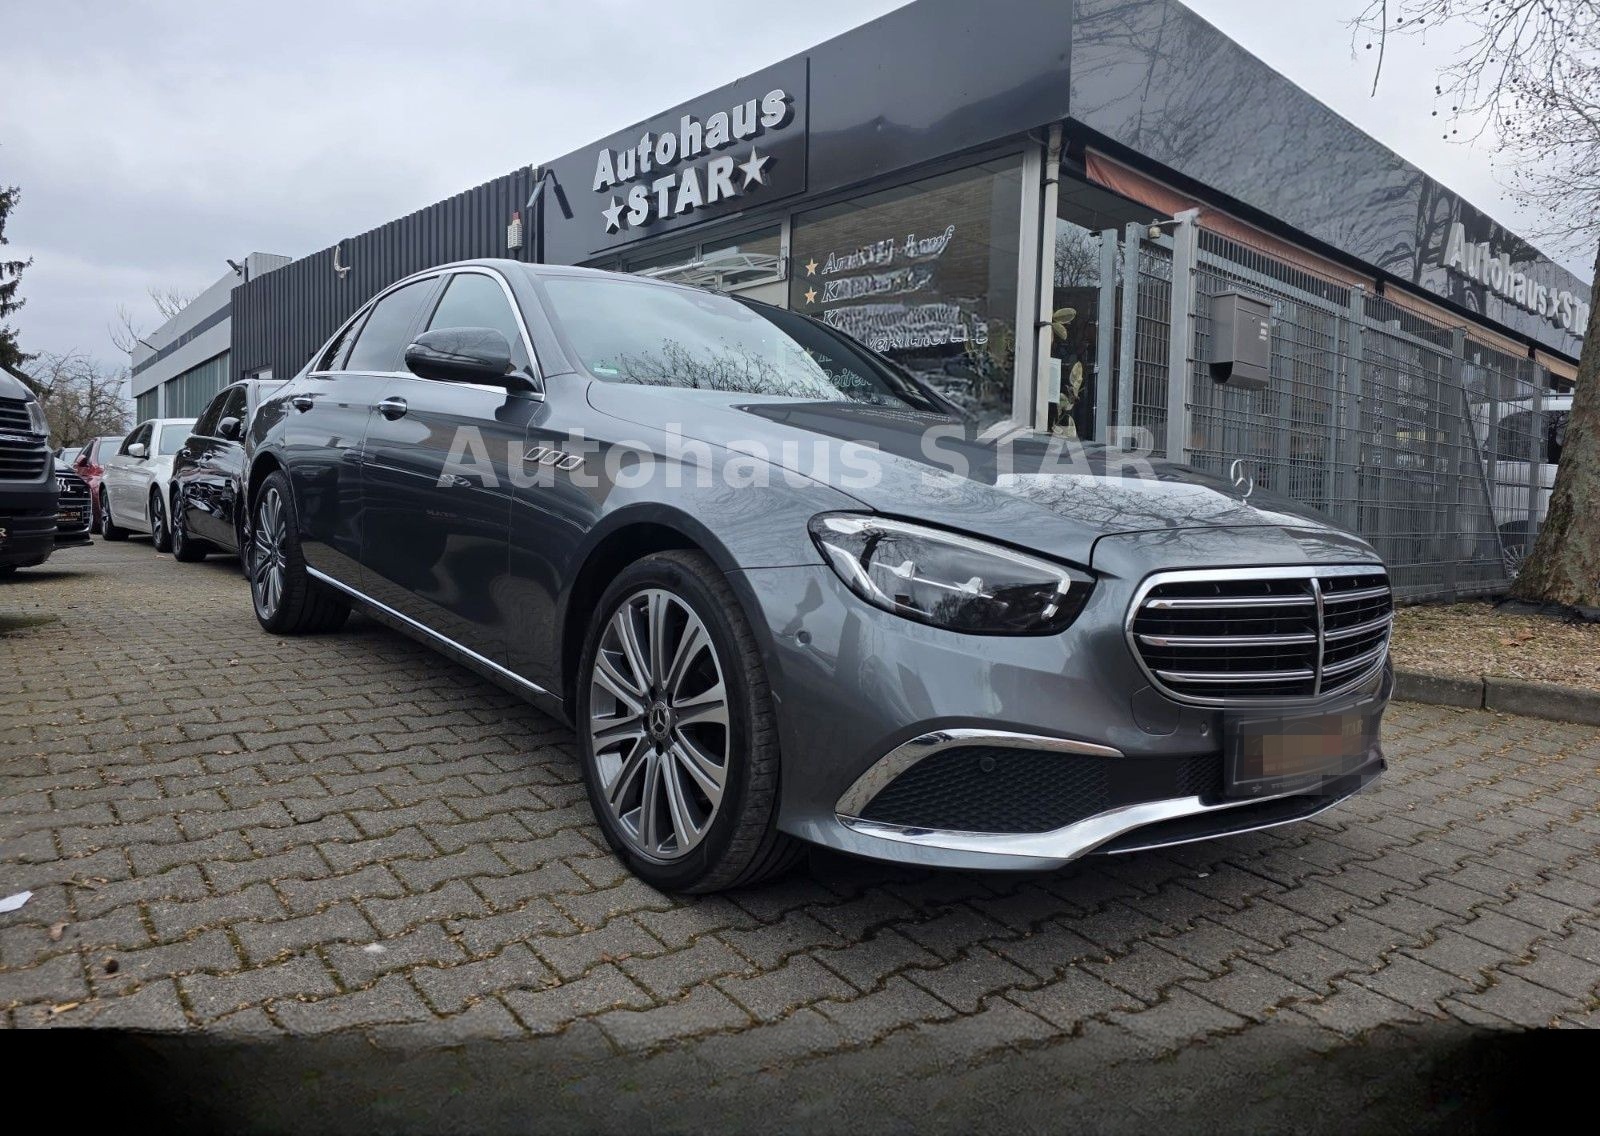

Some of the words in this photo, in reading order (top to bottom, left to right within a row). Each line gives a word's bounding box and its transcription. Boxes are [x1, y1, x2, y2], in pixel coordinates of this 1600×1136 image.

[592, 88, 787, 192] Autohaus
[626, 155, 737, 227] STAR
[1442, 222, 1548, 315] Autohaus
[1558, 291, 1590, 336] ST
